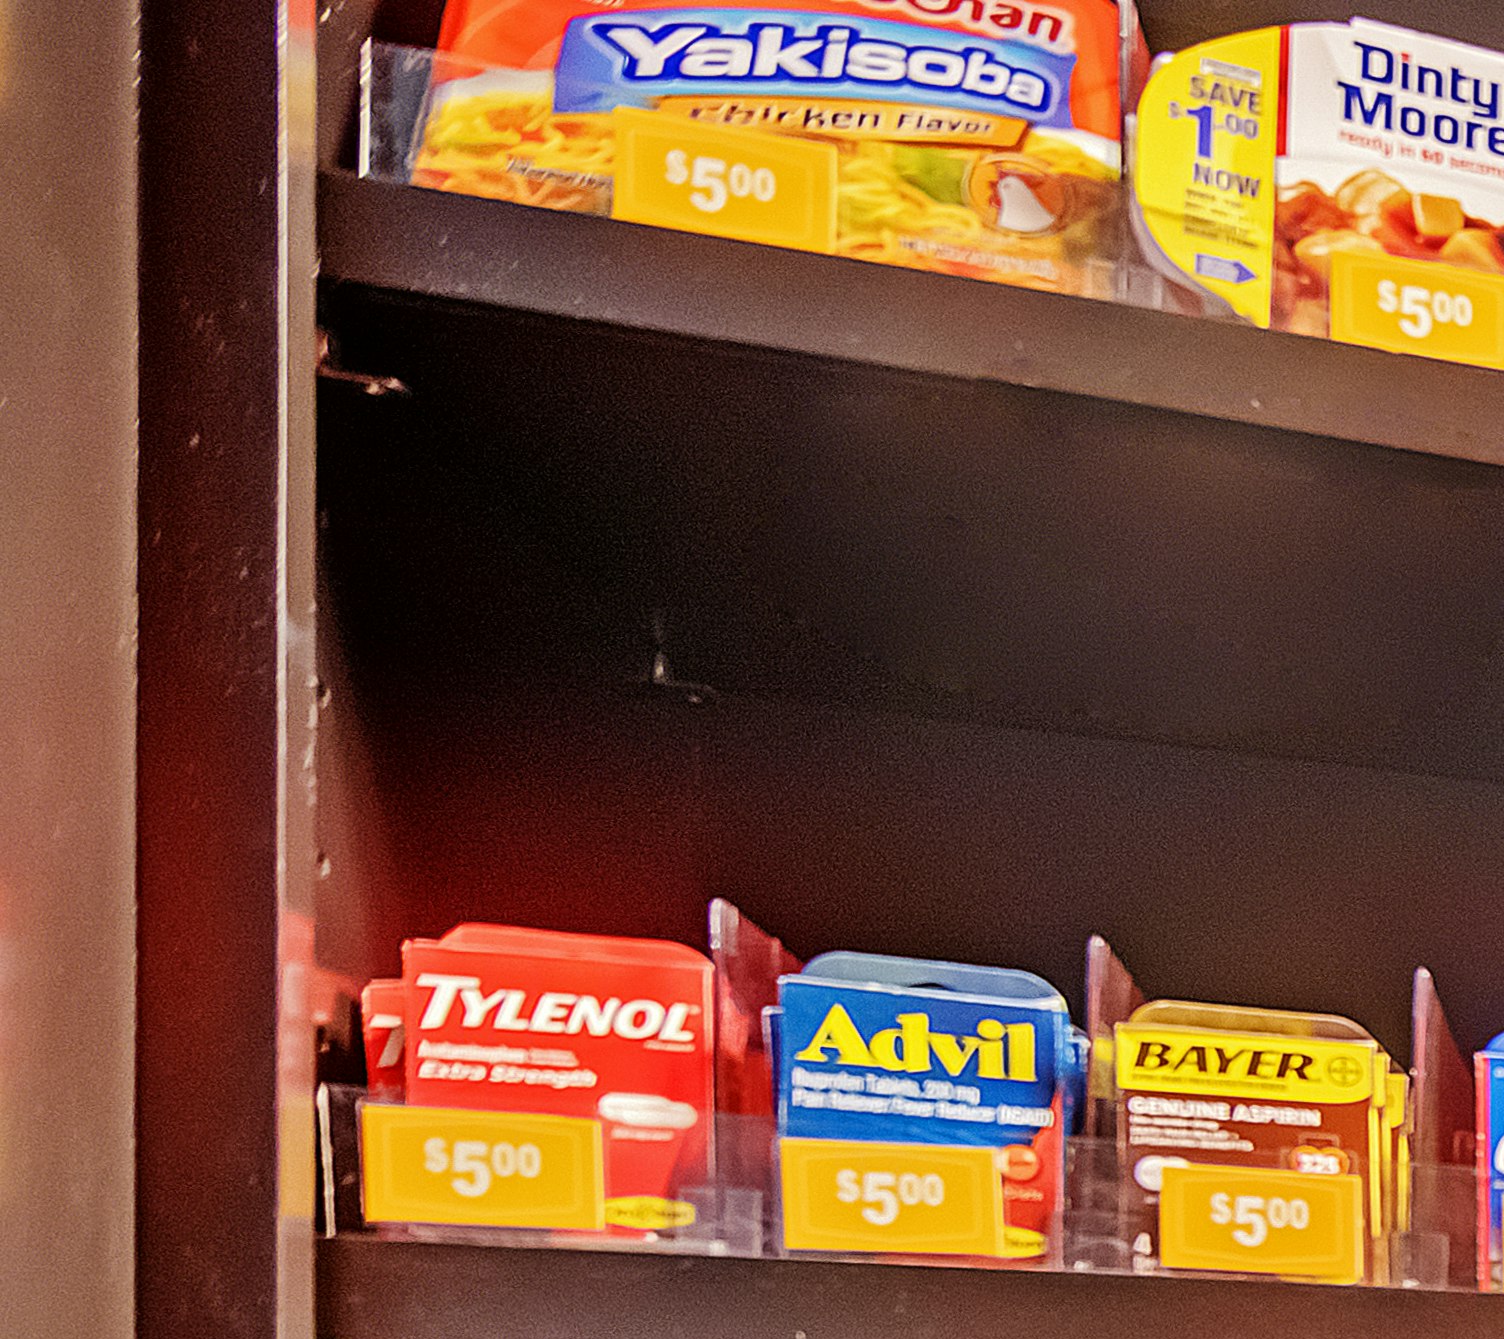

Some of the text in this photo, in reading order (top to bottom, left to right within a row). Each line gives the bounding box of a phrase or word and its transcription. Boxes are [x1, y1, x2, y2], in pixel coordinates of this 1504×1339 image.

[608, 24, 1046, 107] Yakisoba
[1354, 41, 1500, 119] Dinty
[1193, 162, 1261, 199] NOW
[416, 973, 697, 1044] TYLENOL
[795, 1003, 1038, 1083] Advil
[1134, 1040, 1315, 1082] BAYER
